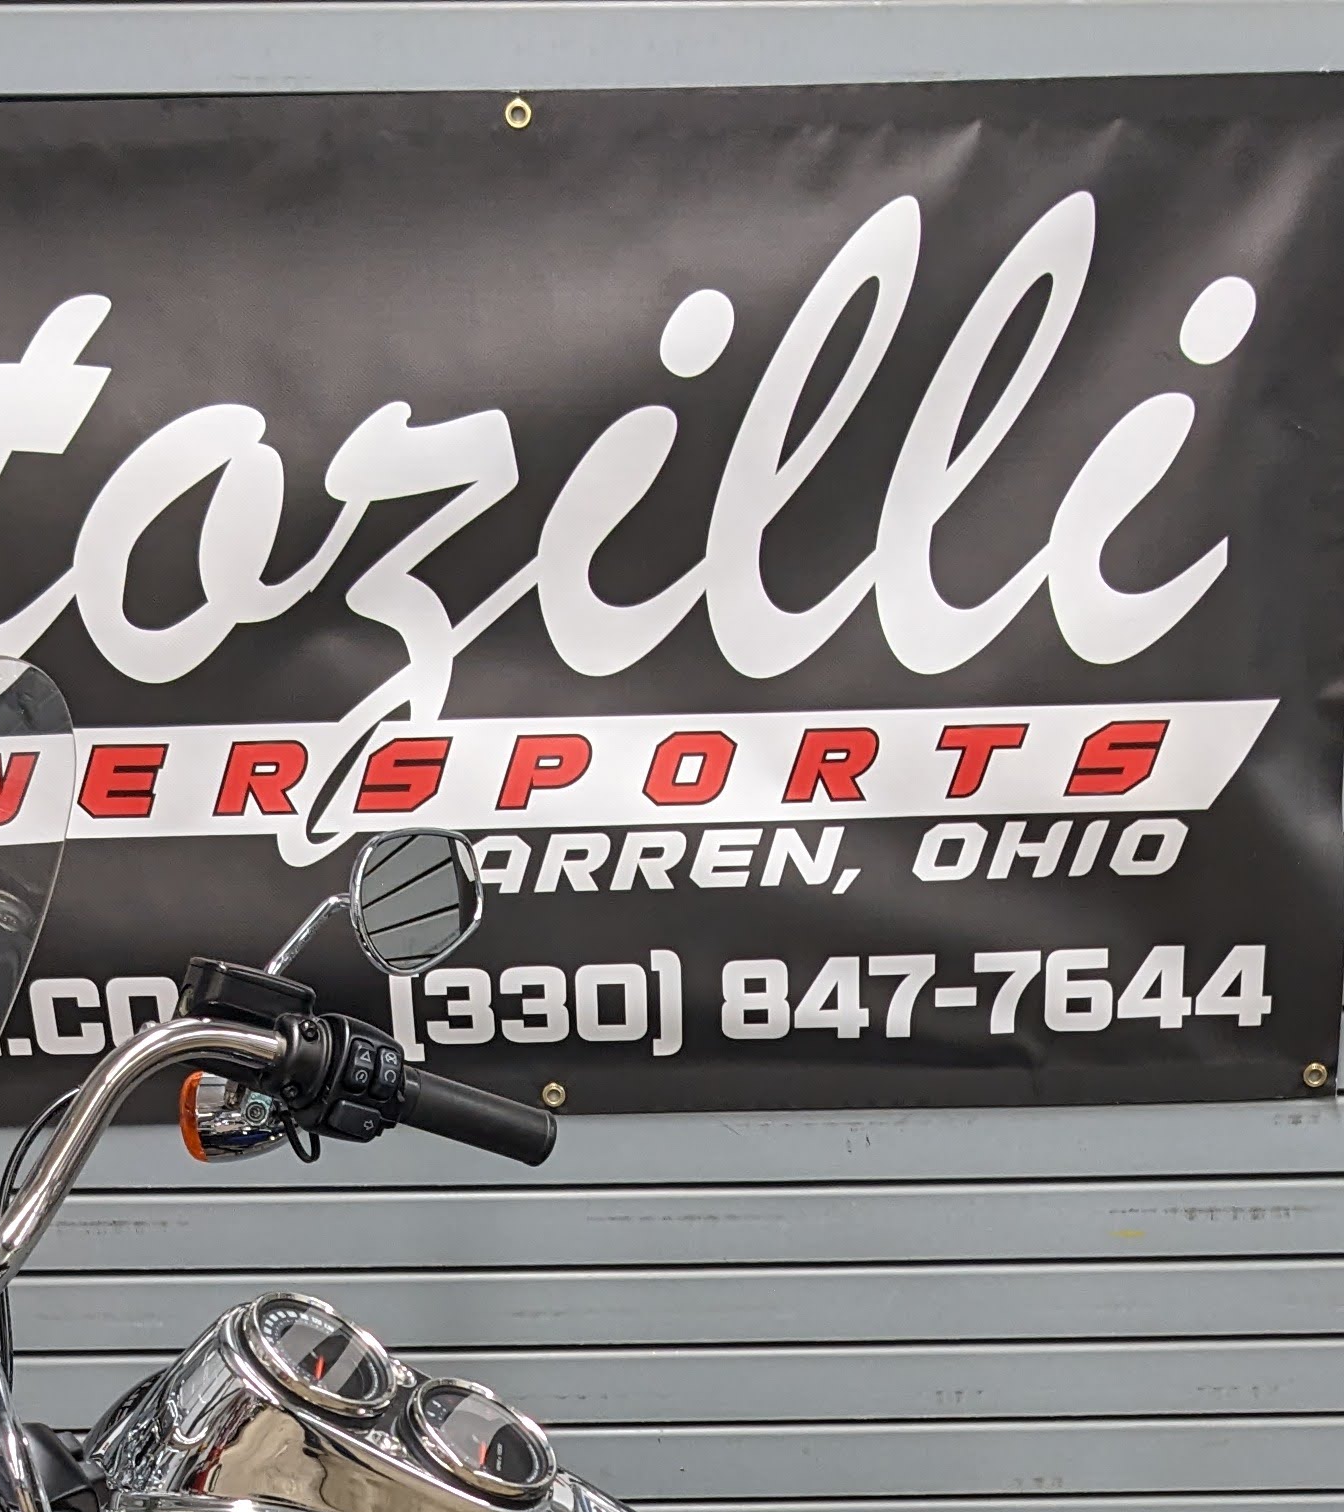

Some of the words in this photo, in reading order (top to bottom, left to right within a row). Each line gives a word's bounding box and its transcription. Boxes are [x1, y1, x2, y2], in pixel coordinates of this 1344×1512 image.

[472, 826, 864, 897] ARREN,
[911, 819, 1189, 882] OHIO
[388, 949, 684, 1062] (330)
[721, 944, 1272, 1040] 847-7644
